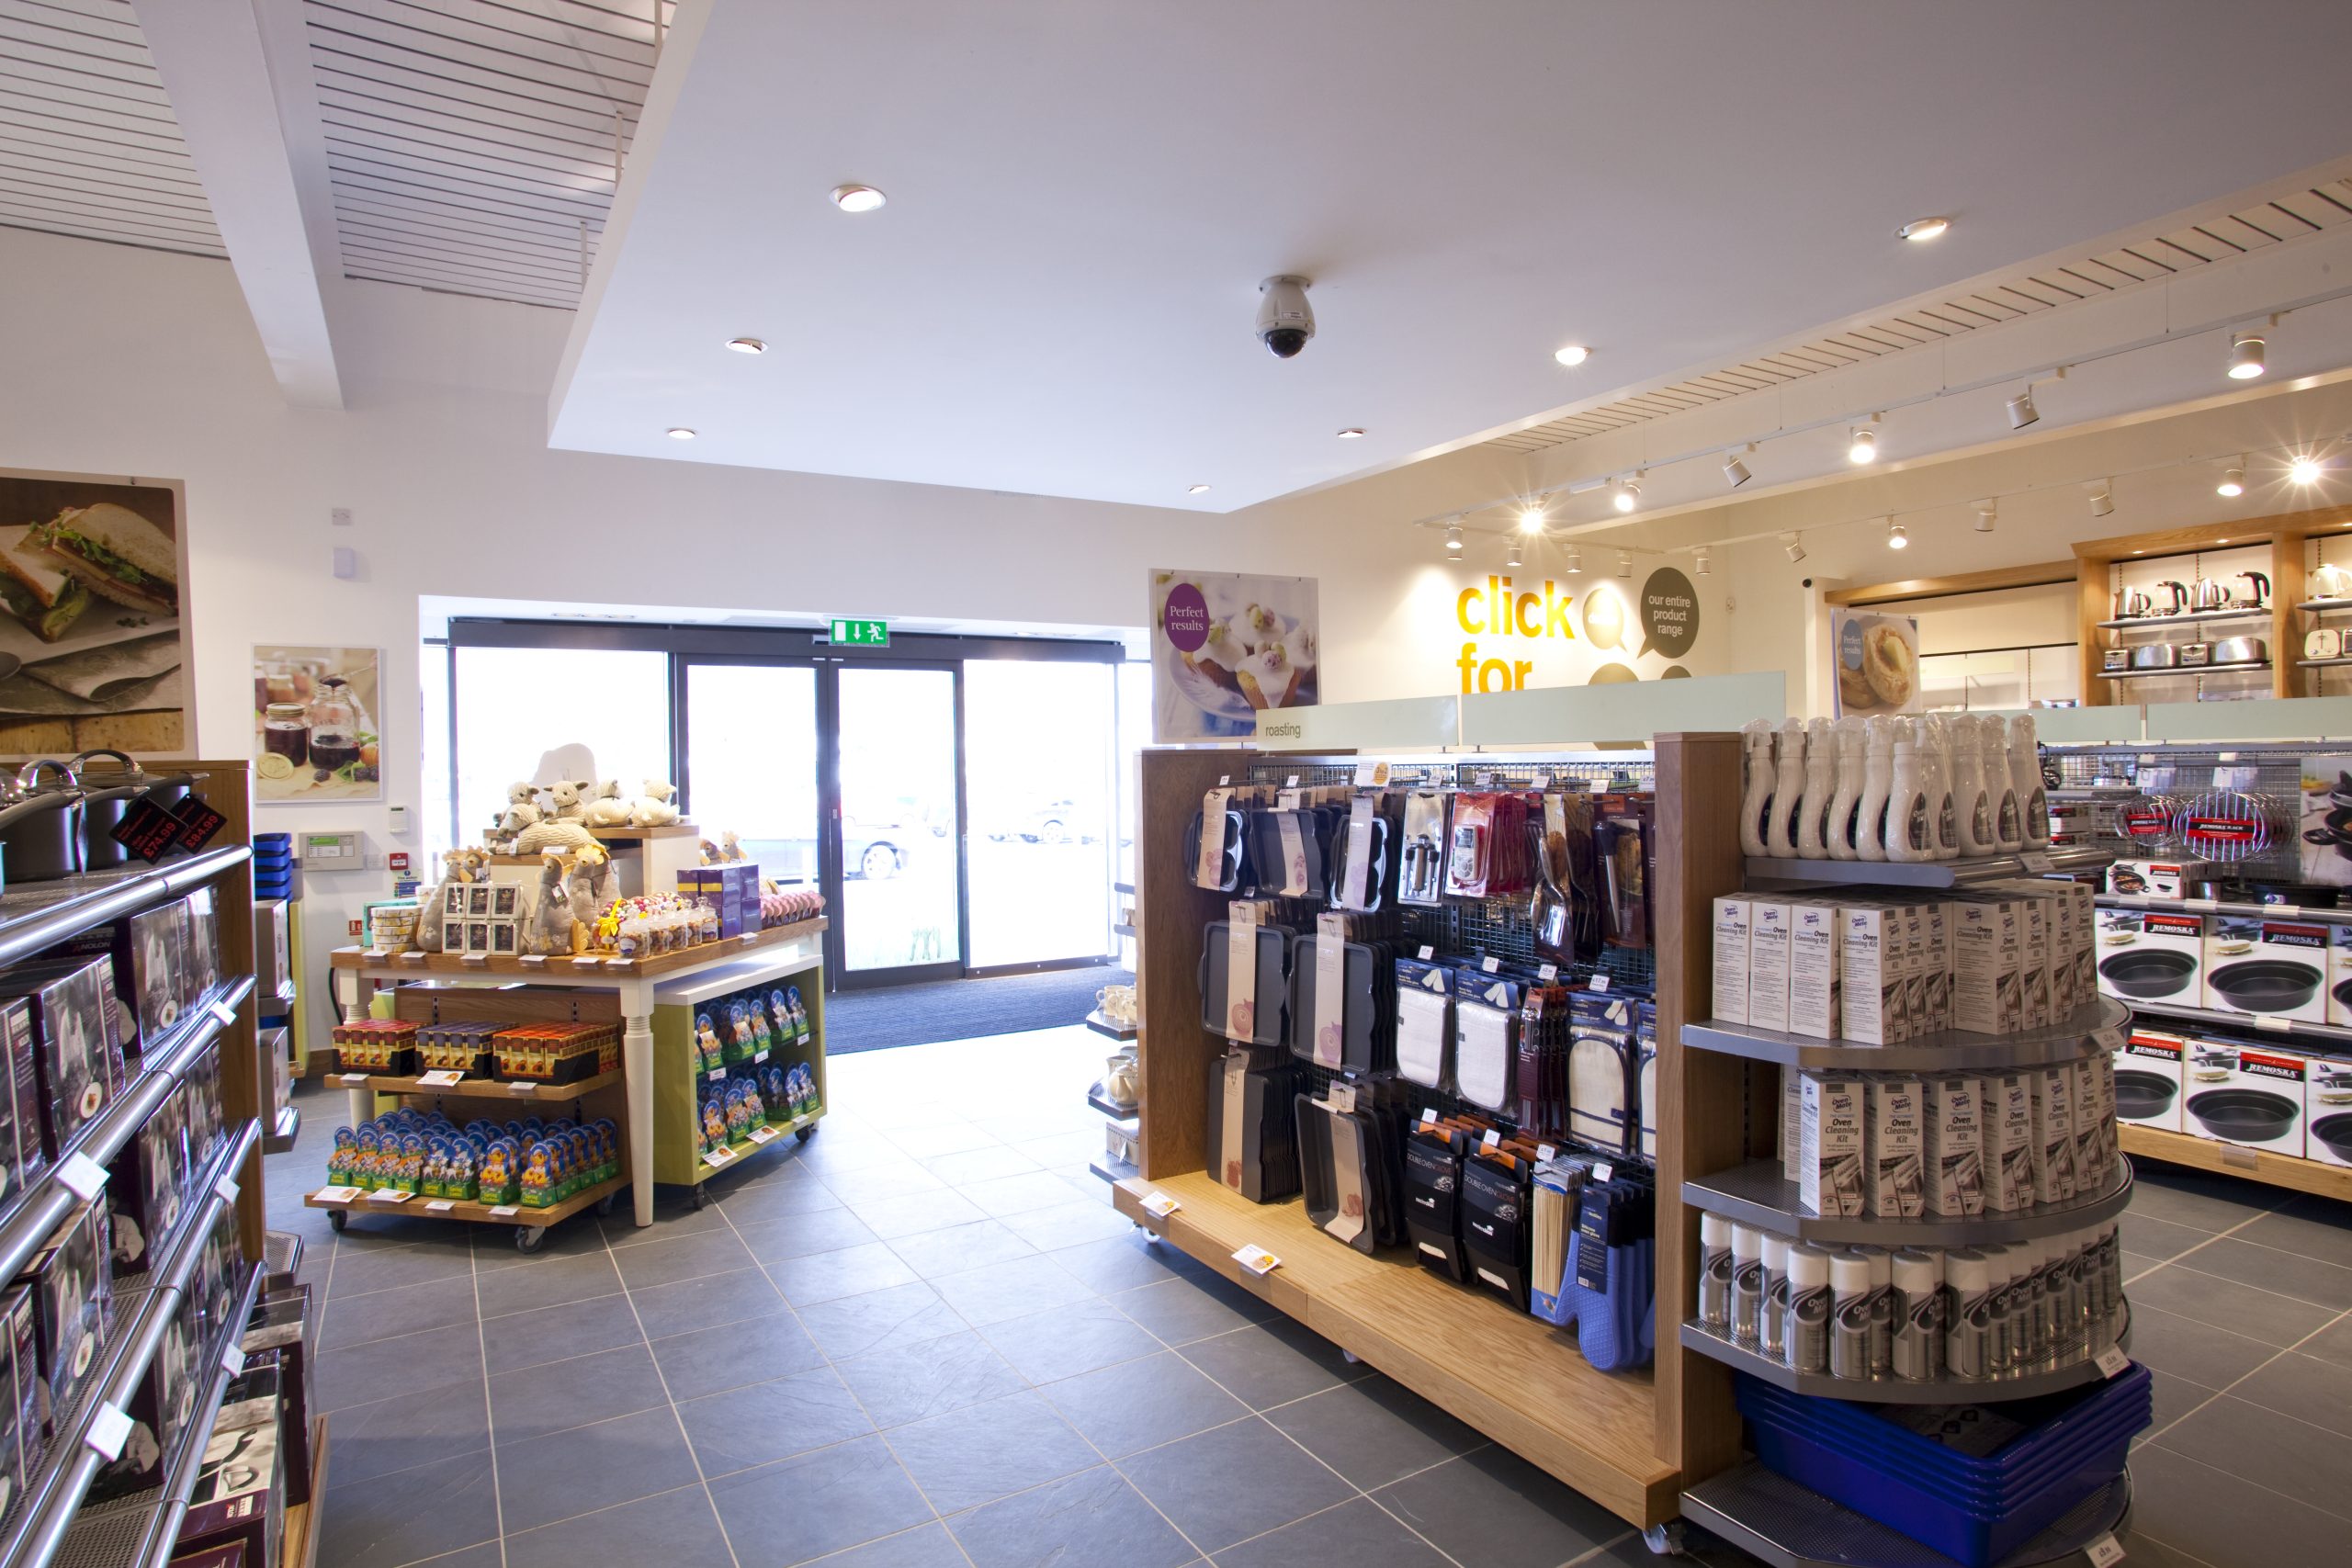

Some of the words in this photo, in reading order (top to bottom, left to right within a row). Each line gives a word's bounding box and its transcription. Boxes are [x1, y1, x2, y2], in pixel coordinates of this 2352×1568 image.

[1456, 575, 1575, 639] click
[1648, 595, 1664, 605] our
[1665, 595, 1691, 608] entire
[1170, 605, 1204, 618] Perfect
[1653, 609, 1687, 622] product
[1171, 619, 1204, 631] results
[1657, 625, 1683, 637] range
[1456, 642, 1532, 694] for
[1265, 723, 1301, 739] roasting
[186, 815, 219, 848] £84.99
[143, 822, 176, 859] £74.99
[1716, 926, 1738, 935] Cleaning
[2150, 924, 2195, 935] REMOSKA
[1755, 931, 1778, 940] Cleaning
[1794, 934, 1819, 944] Cleaning
[1957, 931, 1983, 940] Cleaning
[2269, 932, 2321, 946] REMOSKA
[74, 942, 110, 953] ANOLON
[1843, 938, 1868, 948] Cleaning
[2131, 1045, 2177, 1059] REMOSKA
[2246, 1063, 2298, 1078] REMOSKA
[1832, 1097, 1849, 1105] Oven
[1891, 1097, 1907, 1106] Oven
[1951, 1095, 1967, 1103] Oven
[2052, 1104, 2065, 1112] Oven
[1952, 1116, 1971, 1124] Oven
[2010, 1111, 2024, 1120] Oven
[1832, 1118, 1852, 1126] Oven
[1892, 1119, 1912, 1127] Oven
[1825, 1126, 1860, 1136] Cleaning
[1884, 1126, 1918, 1137] Cleaning
[1946, 1123, 1978, 1134] Cleaning
[1837, 1134, 1849, 1143] Kit
[1896, 1135, 1908, 1144] Kit
